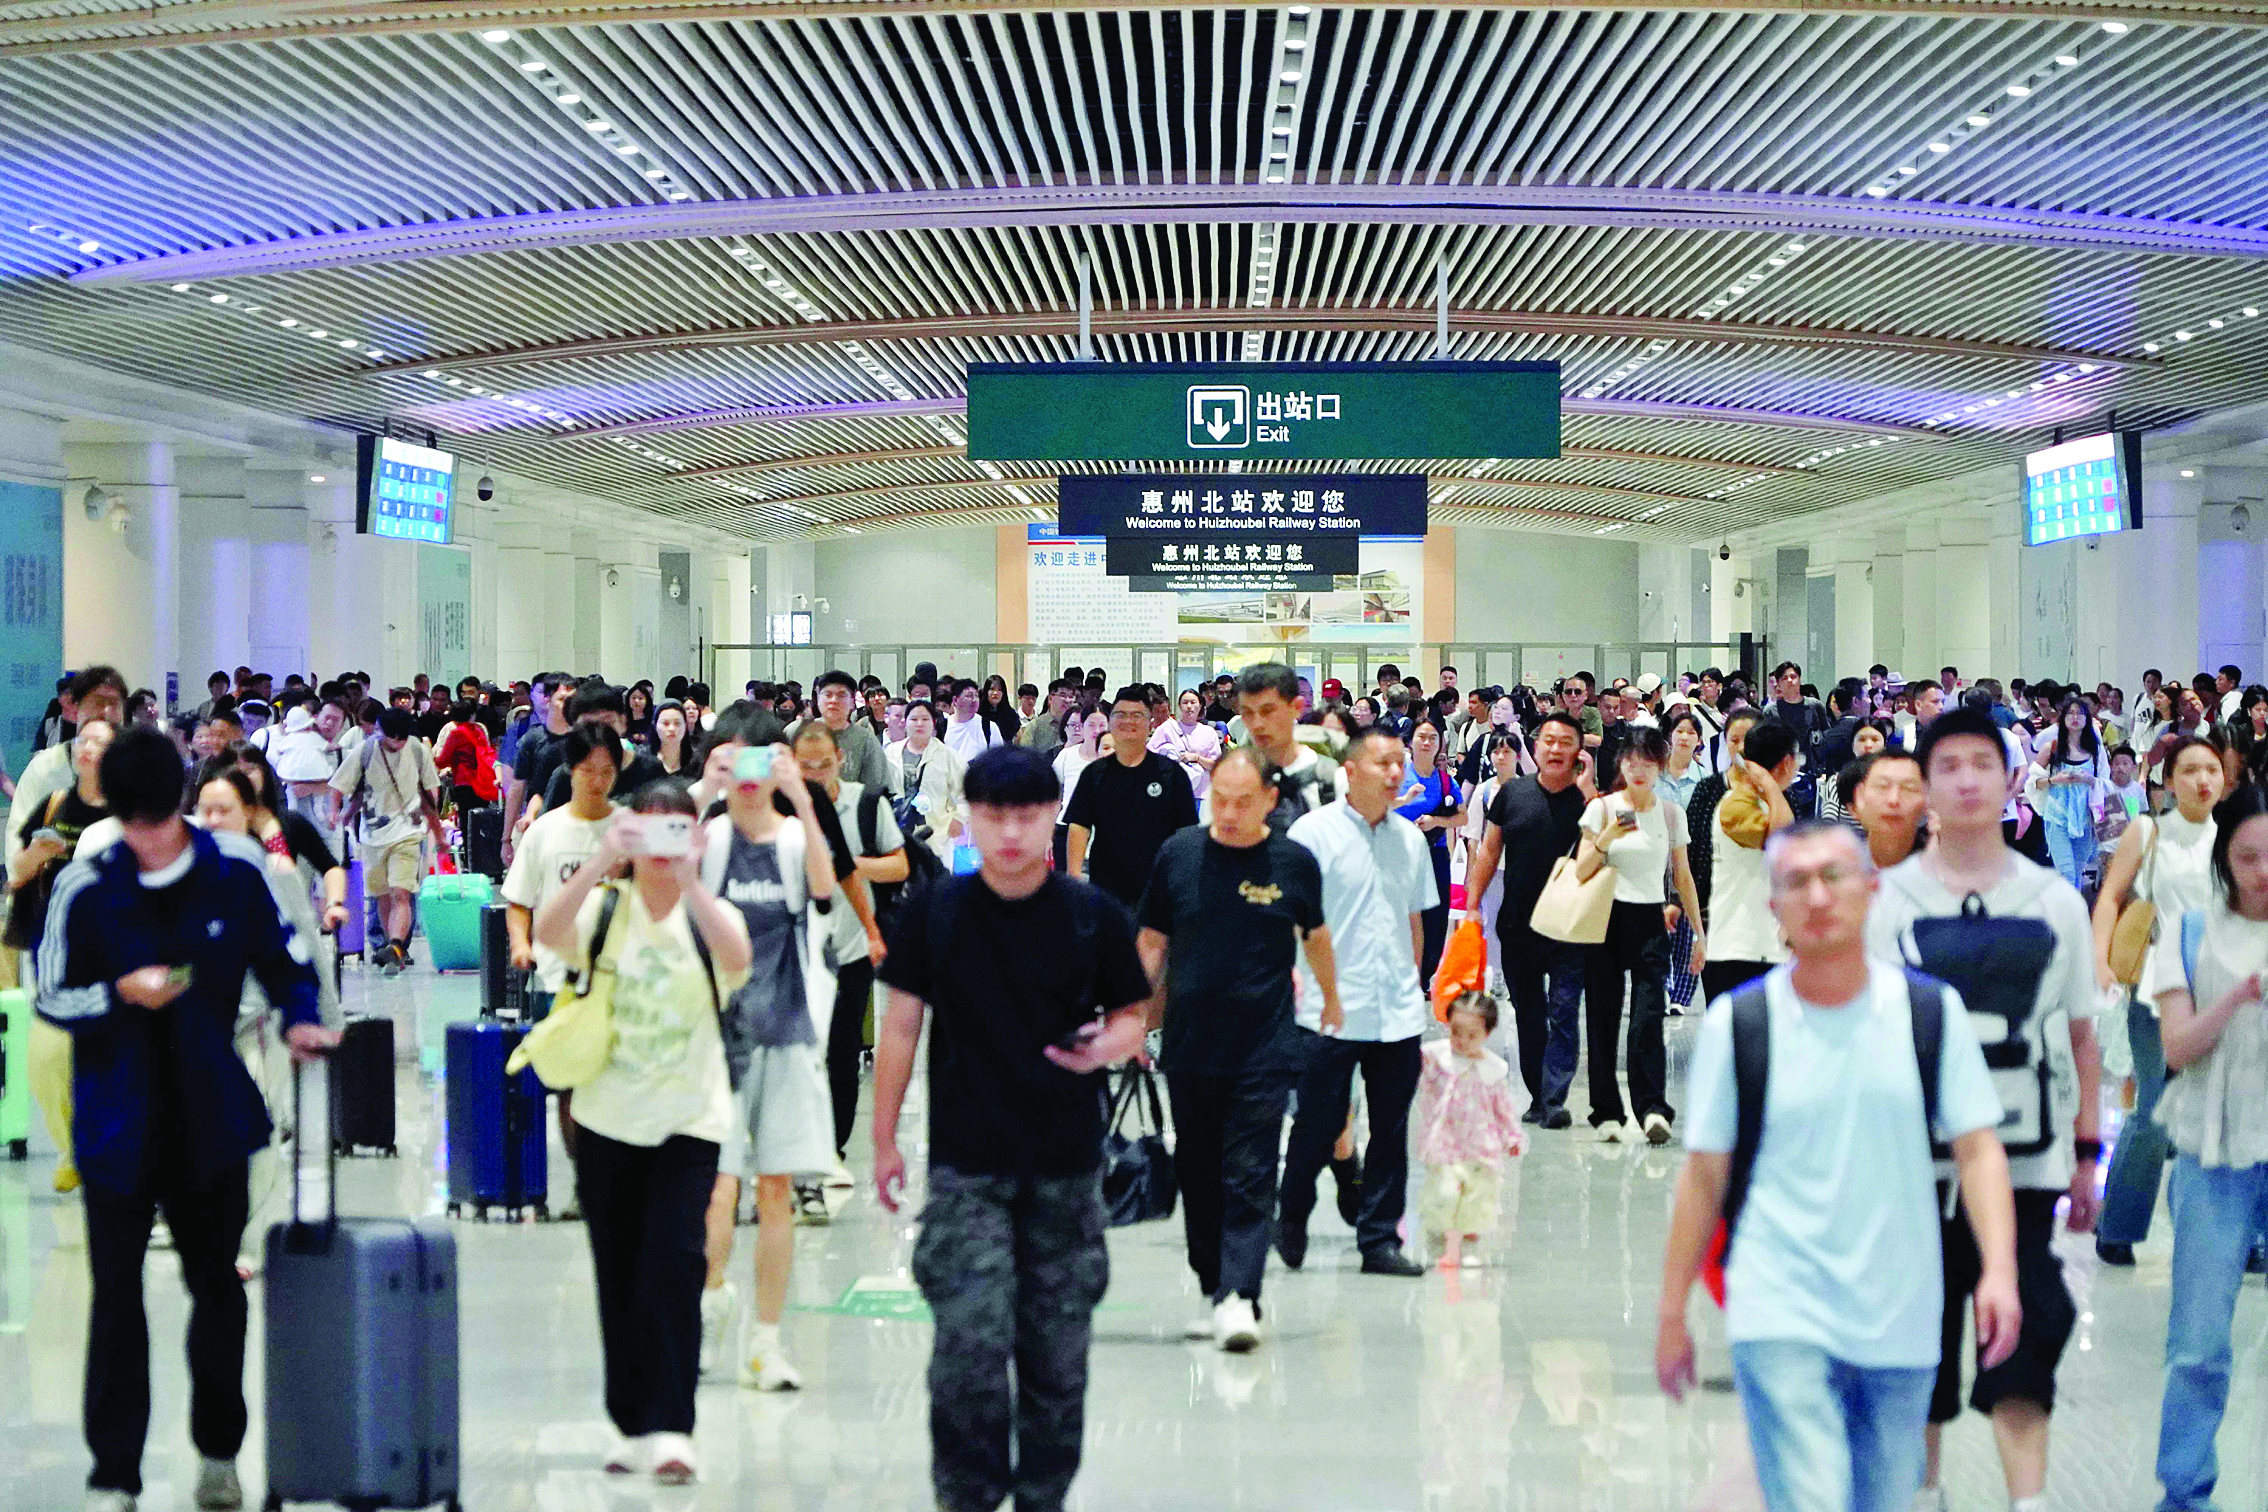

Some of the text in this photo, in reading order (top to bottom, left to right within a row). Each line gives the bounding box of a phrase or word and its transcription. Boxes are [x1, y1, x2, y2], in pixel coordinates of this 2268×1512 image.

[1256, 391, 1341, 422] 出站口
[1256, 425, 1290, 443] Exit
[1141, 489, 1346, 514] 惠州北站欢迎您
[1125, 516, 1361, 532] Welcome to Huizhoubei Railway Station
[1162, 544, 1304, 562] 惠州北站欢迎您
[1152, 562, 1314, 574] Welcome to Huizhoubei Railway Station
[1166, 581, 1198, 590] Welcome
[1199, 581, 1205, 590] to
[1245, 581, 1274, 591] Railway
[1274, 581, 1297, 590] Station
